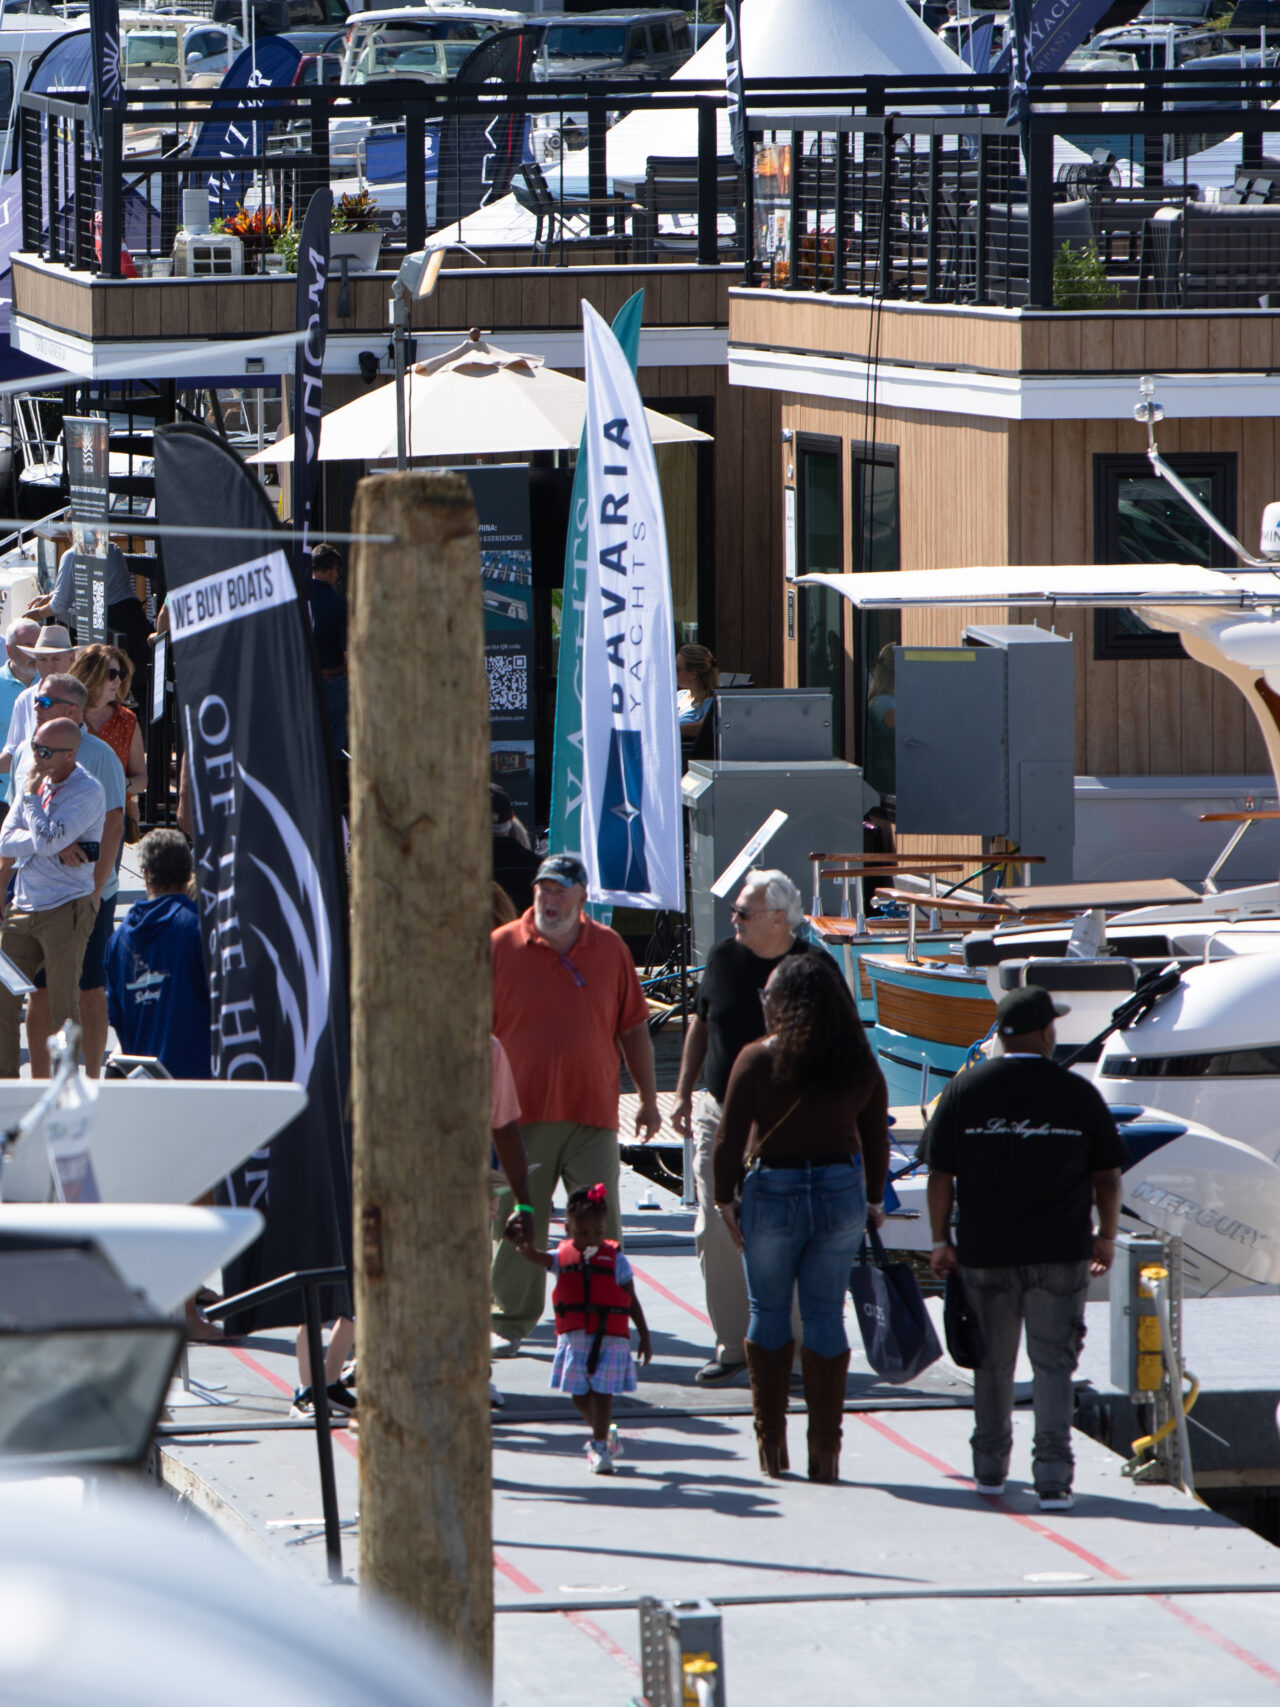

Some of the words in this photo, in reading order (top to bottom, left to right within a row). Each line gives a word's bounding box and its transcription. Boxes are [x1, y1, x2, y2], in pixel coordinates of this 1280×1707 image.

[1035, 27, 1072, 72] MPANY
[172, 596, 194, 631] WE
[195, 581, 224, 621] BUY
[226, 564, 274, 611] BOATS
[599, 417, 631, 716] BAVARIA
[629, 521, 647, 713] YACHTS
[198, 694, 236, 817] OFF
[218, 835, 248, 977] THE
[1131, 1181, 1266, 1249] MERCURY
